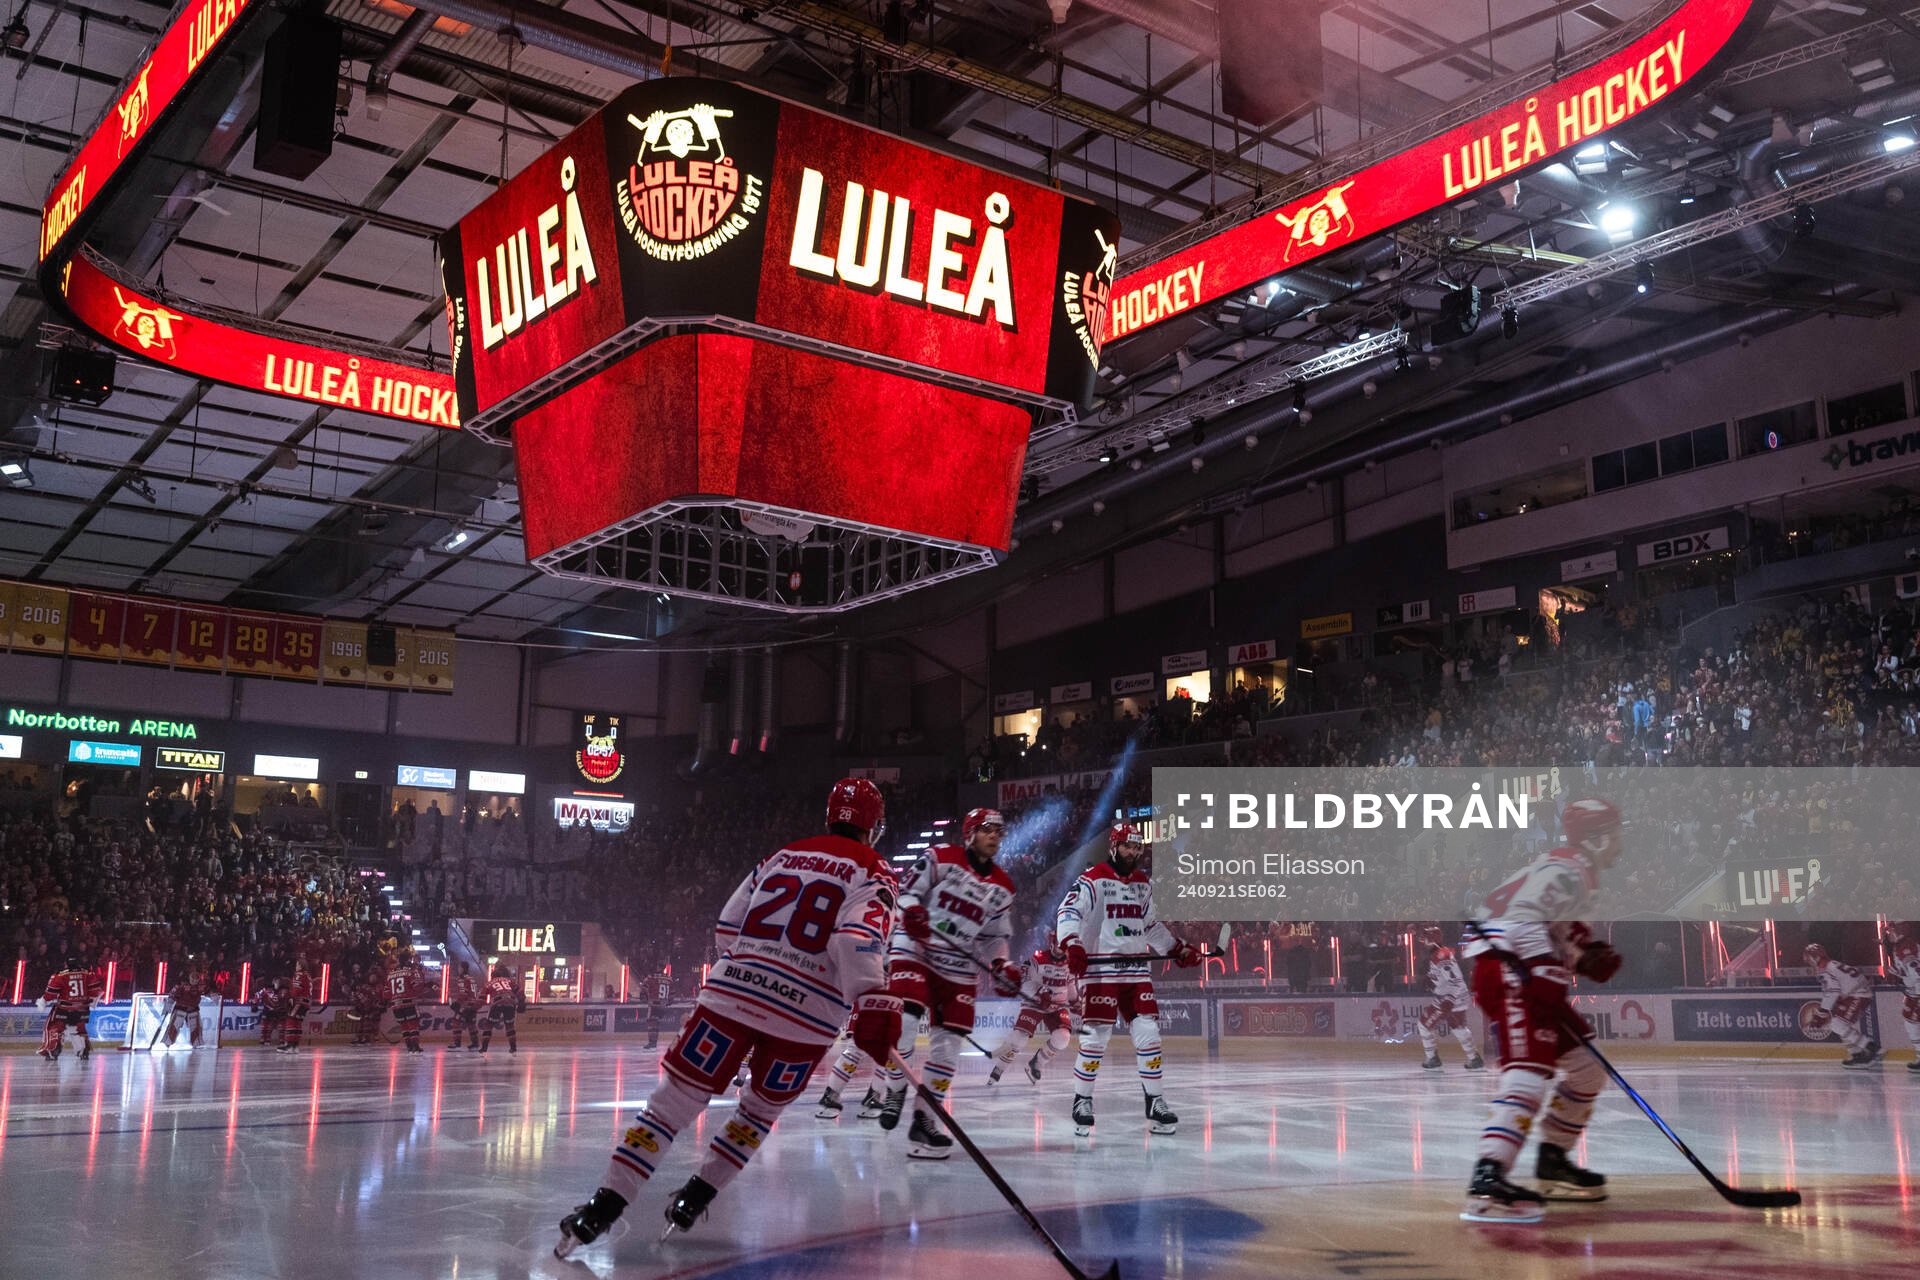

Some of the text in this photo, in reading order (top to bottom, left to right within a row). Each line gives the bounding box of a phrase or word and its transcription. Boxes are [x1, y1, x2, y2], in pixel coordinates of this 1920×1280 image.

[1443, 30, 1687, 198] LULEÅ HOCKEY
[630, 157, 739, 190] LULEÅ
[45, 165, 87, 253] HOCKEY
[616, 174, 764, 262] LULEÅ HOCKEYFÖRENING 1977
[633, 186, 736, 240] HOCKEY
[477, 156, 597, 349] LULEÅ
[789, 191, 1015, 326] LULEÅ
[1112, 261, 1205, 334] HOCKEY
[264, 355, 361, 407] LULEÅ
[1653, 532, 1712, 560] BDX
[22, 606, 61, 625] 2016
[90, 607, 106, 635] 4
[143, 614, 159, 640] 7
[1304, 618, 1349, 633] Assemblin
[190, 620, 215, 647] 12
[236, 625, 268, 654] 28
[283, 631, 314, 658] 35
[331, 641, 362, 658] 1996
[419, 650, 449, 665] 2015
[1237, 643, 1268, 662] ABB
[8, 708, 198, 740] Norrbotten ARENA
[584, 715, 620, 726] LHF TIK
[586, 724, 617, 739] 0 0
[162, 750, 220, 765] TITAN
[561, 803, 610, 821] MAXI
[840, 809, 852, 820] 28
[740, 873, 847, 955] 28
[497, 923, 556, 952] LULEÅ
[68, 980, 84, 997] 31
[390, 977, 405, 995] 13
[658, 984, 670, 999] 91
[724, 965, 809, 1005] BILBOLAGET
[1090, 995, 1118, 1007] coop
[527, 1014, 605, 1026] ZEPPELIN CAT
[1696, 1010, 1792, 1029] Helt enkelt
